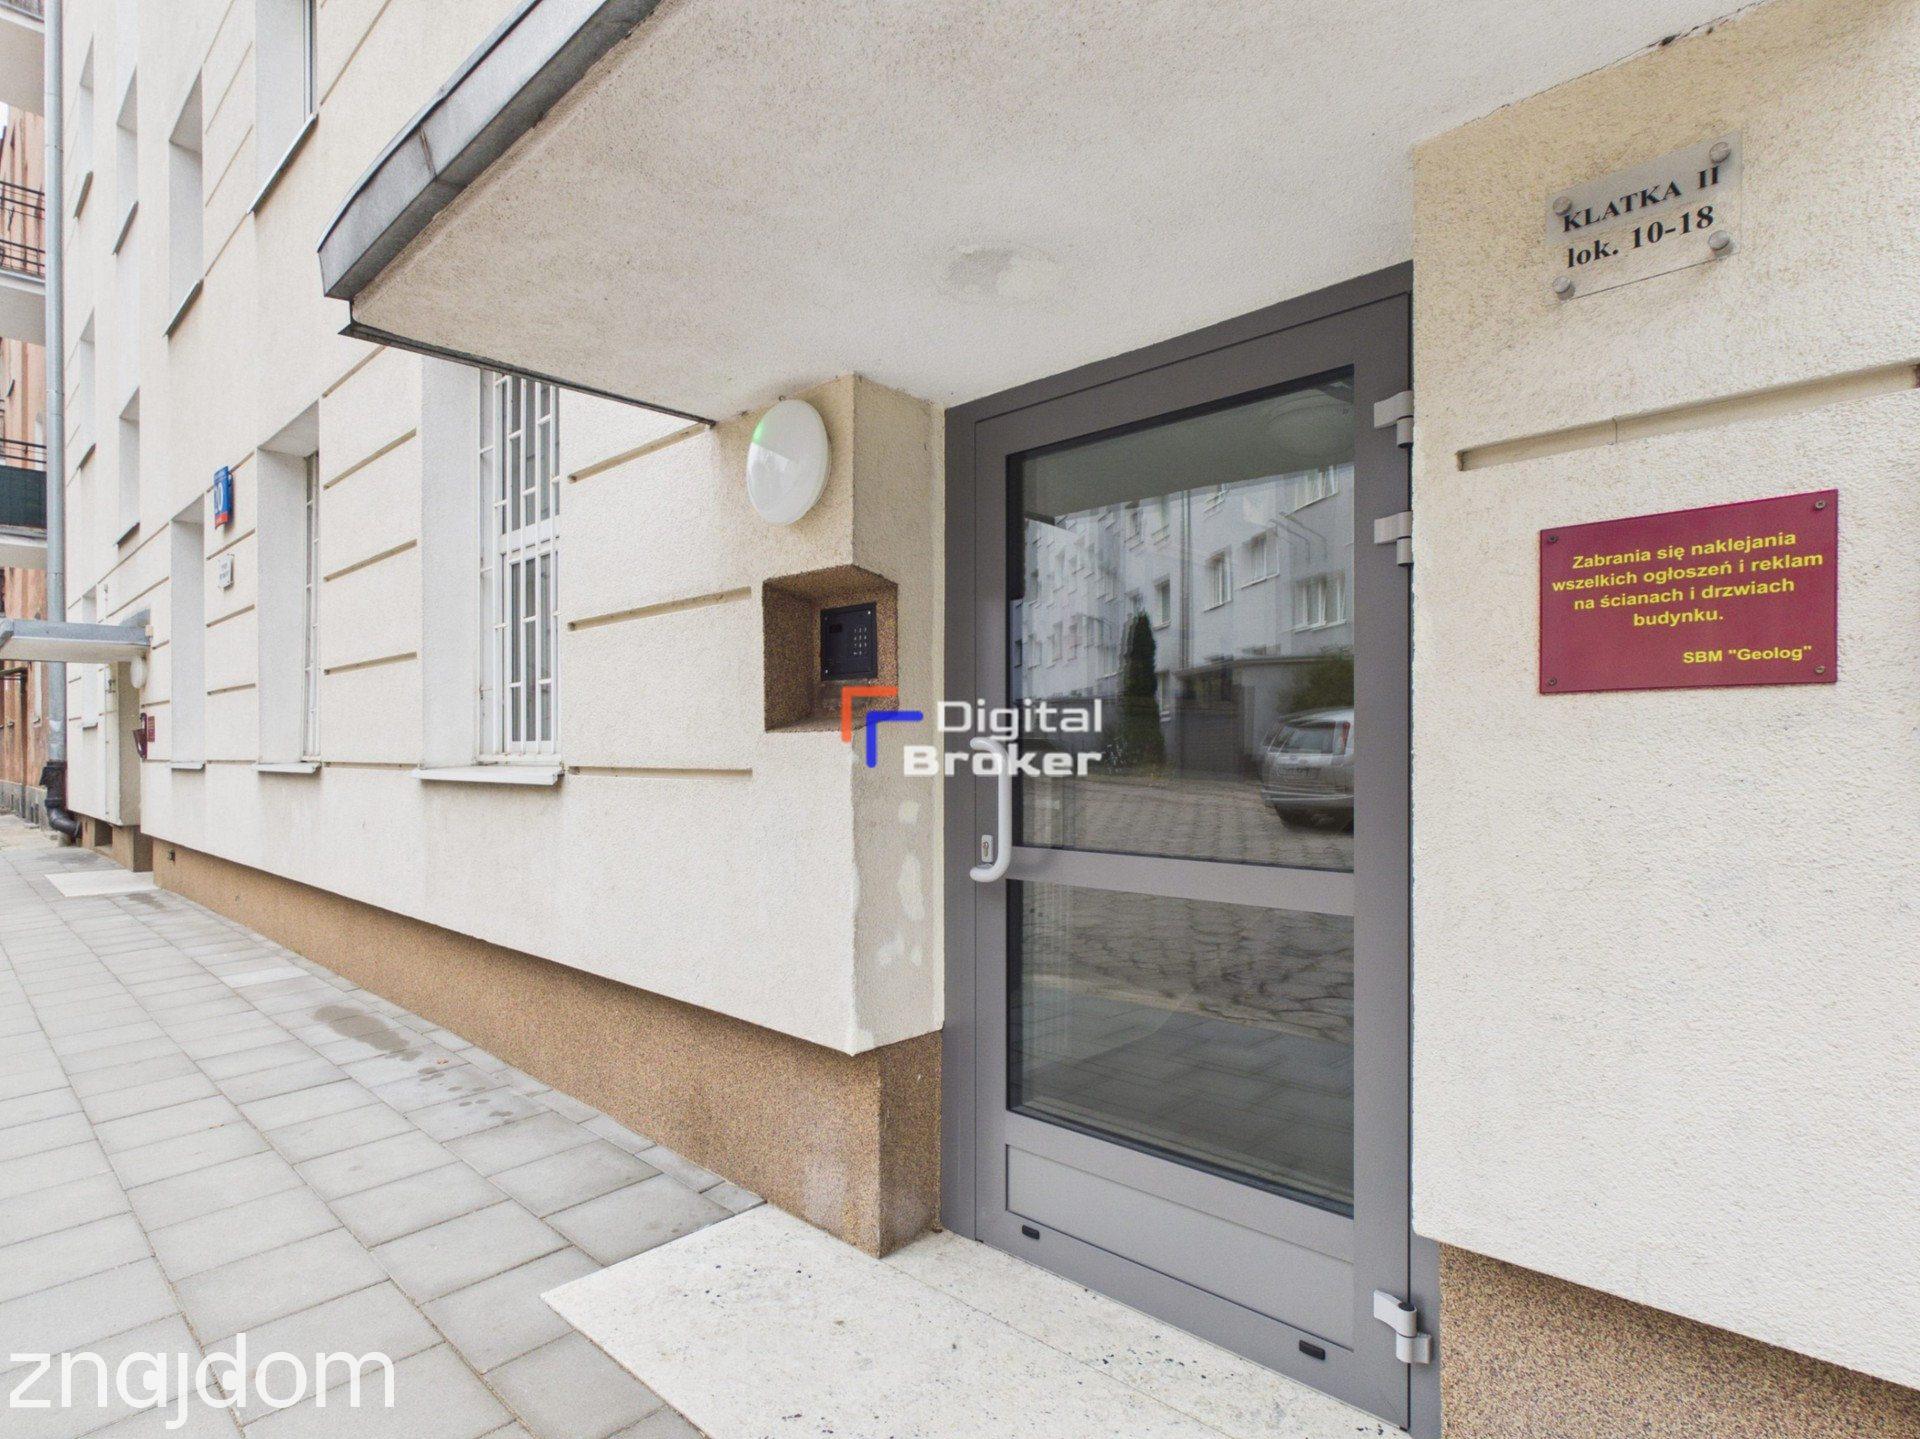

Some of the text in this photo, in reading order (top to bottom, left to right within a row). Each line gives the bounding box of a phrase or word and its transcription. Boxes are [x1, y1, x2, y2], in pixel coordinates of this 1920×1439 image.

[1563, 165, 1720, 233] KLATKA II
[1567, 205, 1714, 269] lok. 10-18
[1572, 532, 1797, 570] Zabrania się naklejania
[1552, 553, 1824, 592] wszelkich ogłoszeń i reklam
[1574, 577, 1795, 610] na ścianach i drzwiach
[1633, 608, 1724, 627] budynku.
[1683, 645, 1812, 664] SBM "Geolog"
